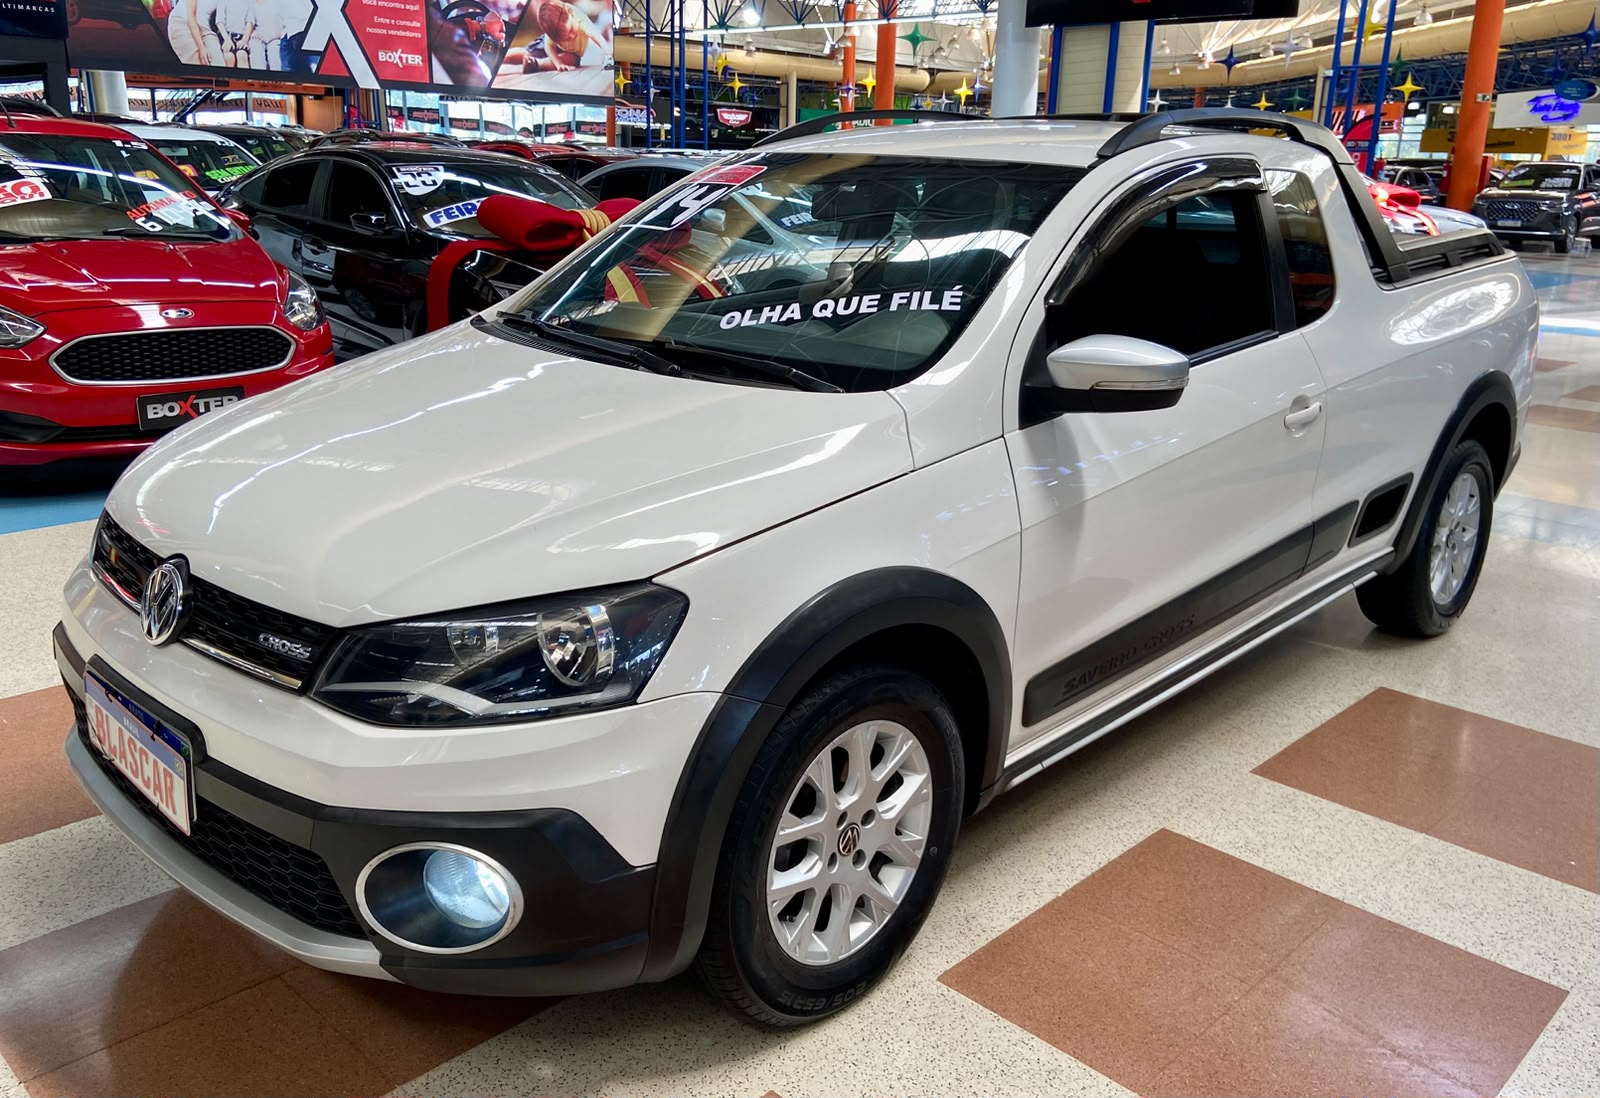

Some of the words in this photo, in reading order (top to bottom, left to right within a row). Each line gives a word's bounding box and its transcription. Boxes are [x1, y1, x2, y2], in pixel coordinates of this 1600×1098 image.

[378, 0, 404, 9] encontra
[366, 27, 387, 35] nossos
[388, 29, 422, 38] vendedores
[374, 16, 390, 25] Entre
[396, 19, 421, 28] consulte
[378, 48, 423, 68] BOXTER
[126, 189, 198, 221] AUTOMACO
[430, 201, 480, 225] FEIR
[719, 303, 802, 330] OLHA
[812, 294, 882, 318] QUE
[888, 285, 964, 312] FILÉ
[258, 632, 312, 659] CROSS
[1062, 646, 1137, 696] SAVEIRO
[1143, 613, 1196, 649] CROSS
[94, 704, 178, 816] BLASCAR
